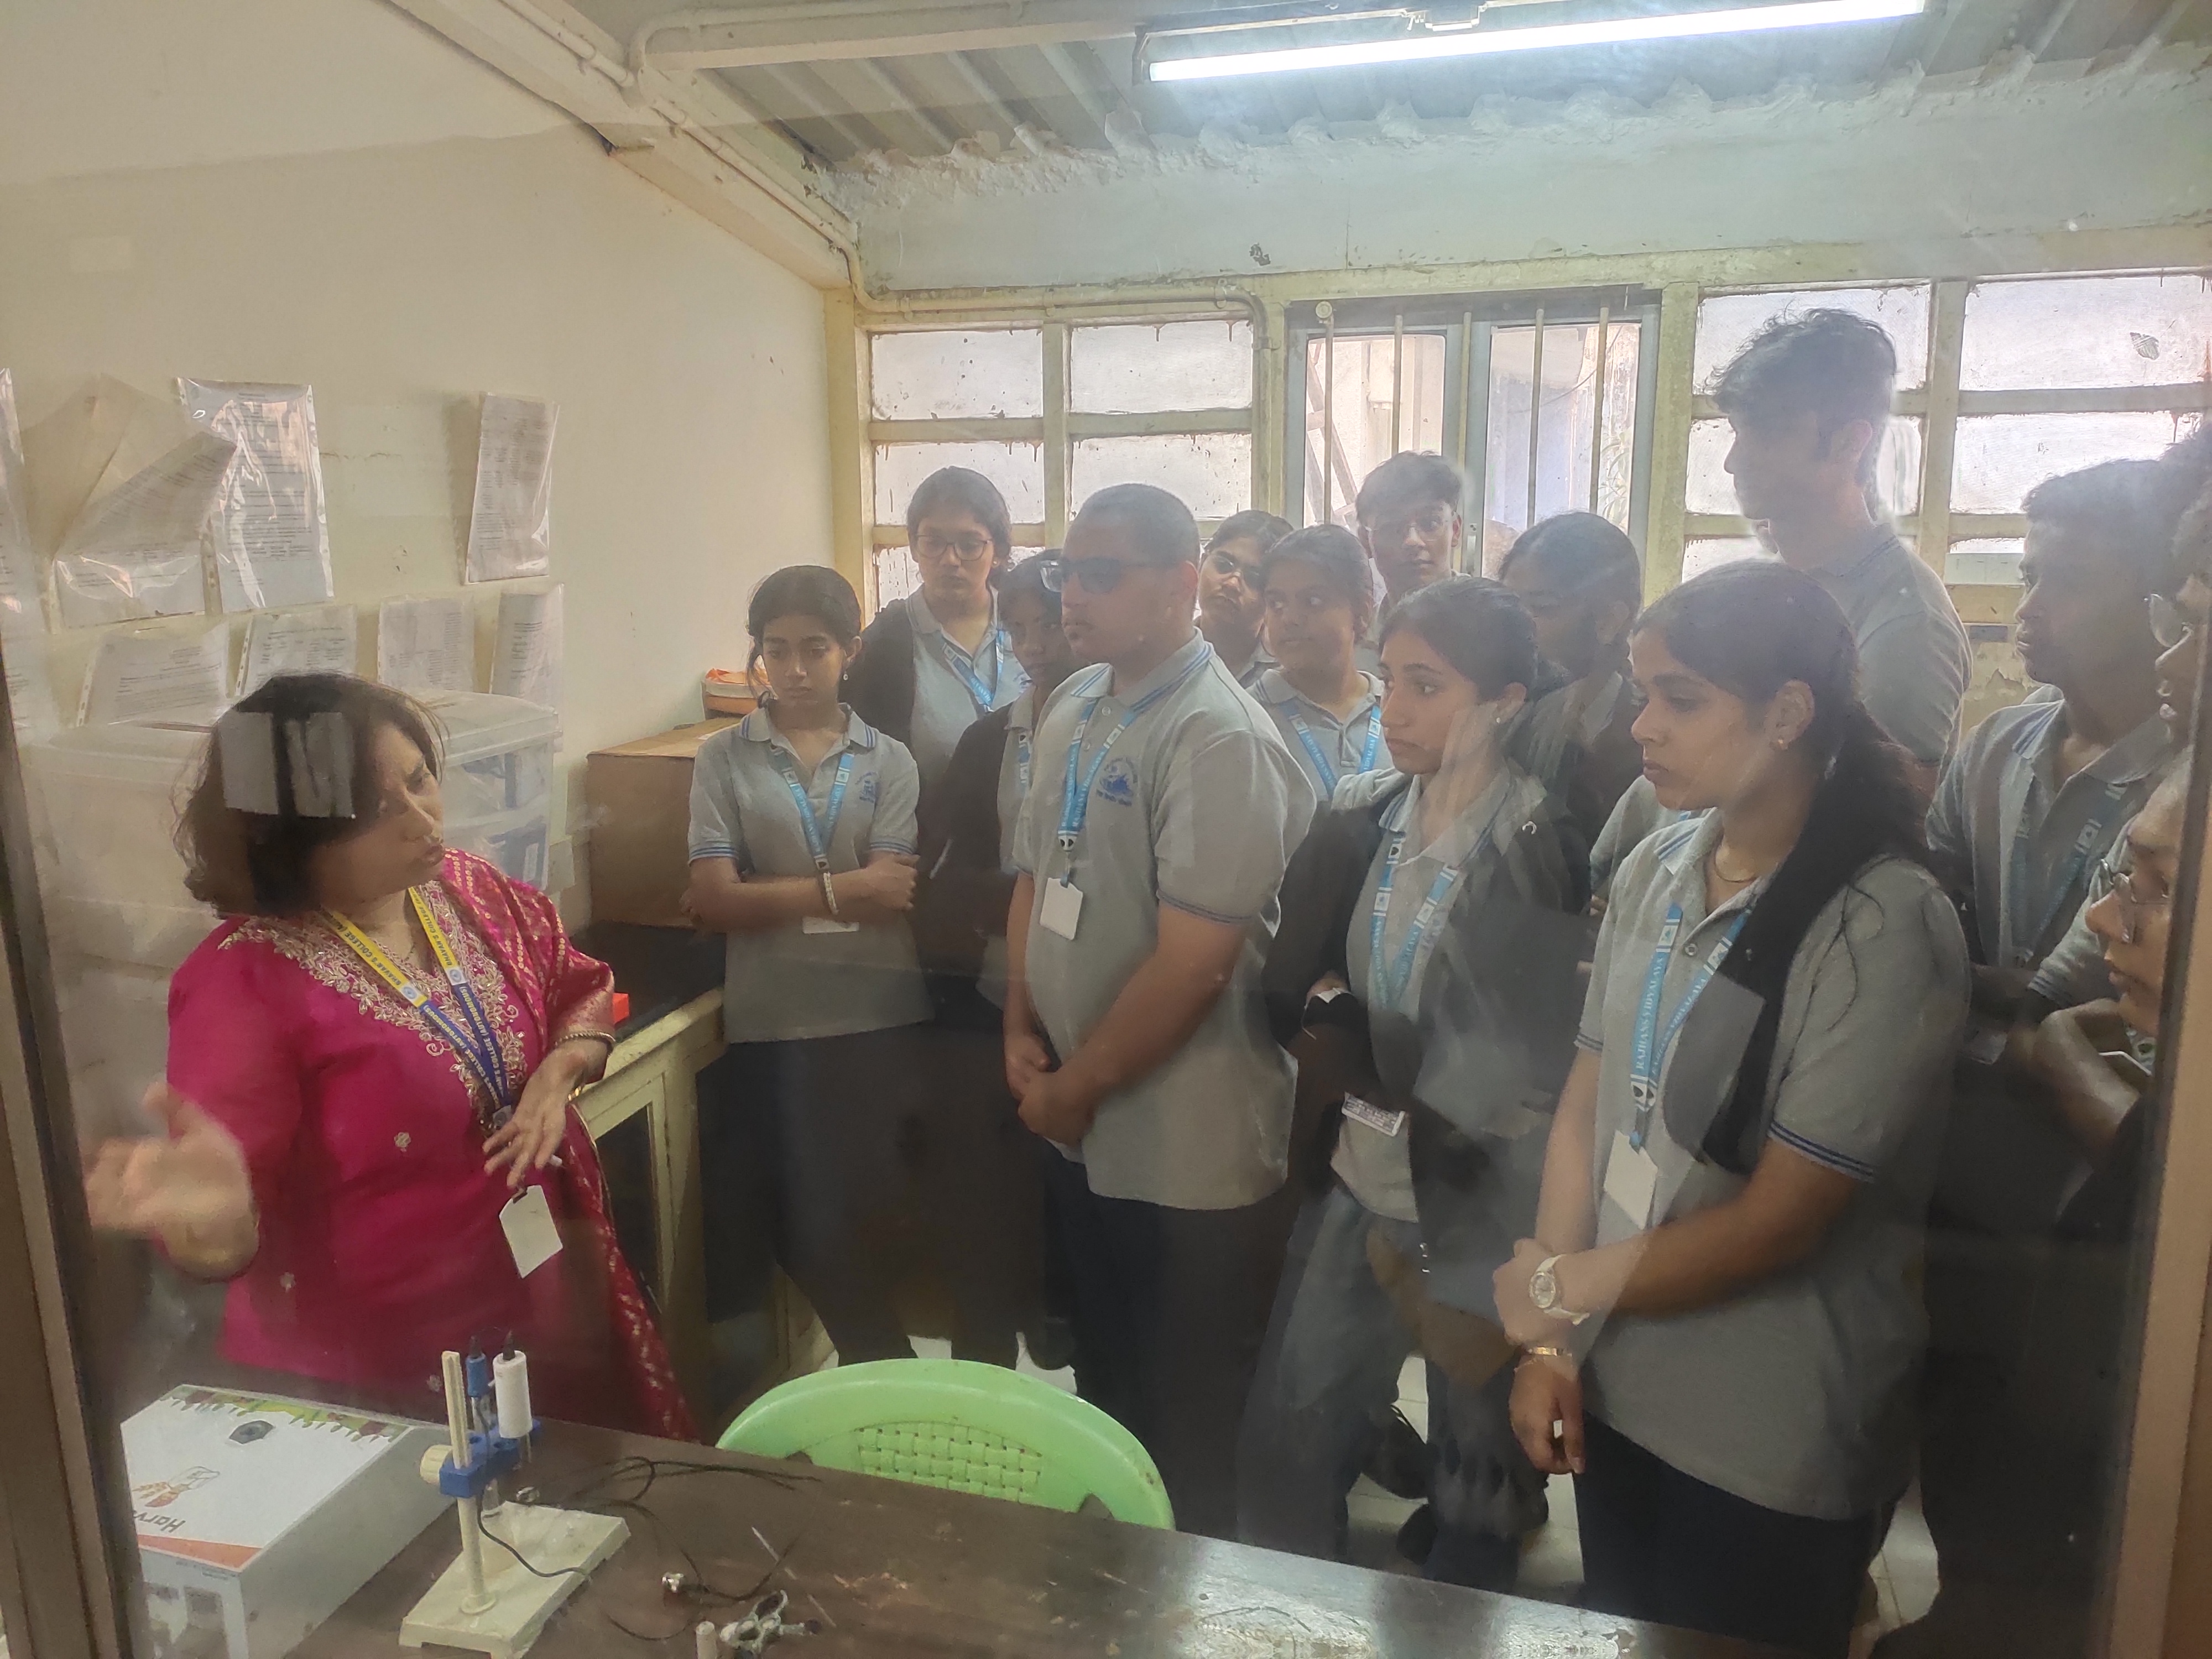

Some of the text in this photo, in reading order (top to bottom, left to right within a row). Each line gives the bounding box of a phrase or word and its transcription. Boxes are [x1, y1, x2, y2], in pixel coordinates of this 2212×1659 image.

[345, 931, 402, 986] BHAVAN'S COLLEGE
[419, 906, 453, 966] BHAVAN'S COLLEGE
[424, 1005, 467, 1049] (AUTONOMOUS)
[460, 987, 489, 1036] (AUTONOMOUS)
[465, 1048, 486, 1077] COLLEGE
[483, 1037, 499, 1069] COLLEGE
